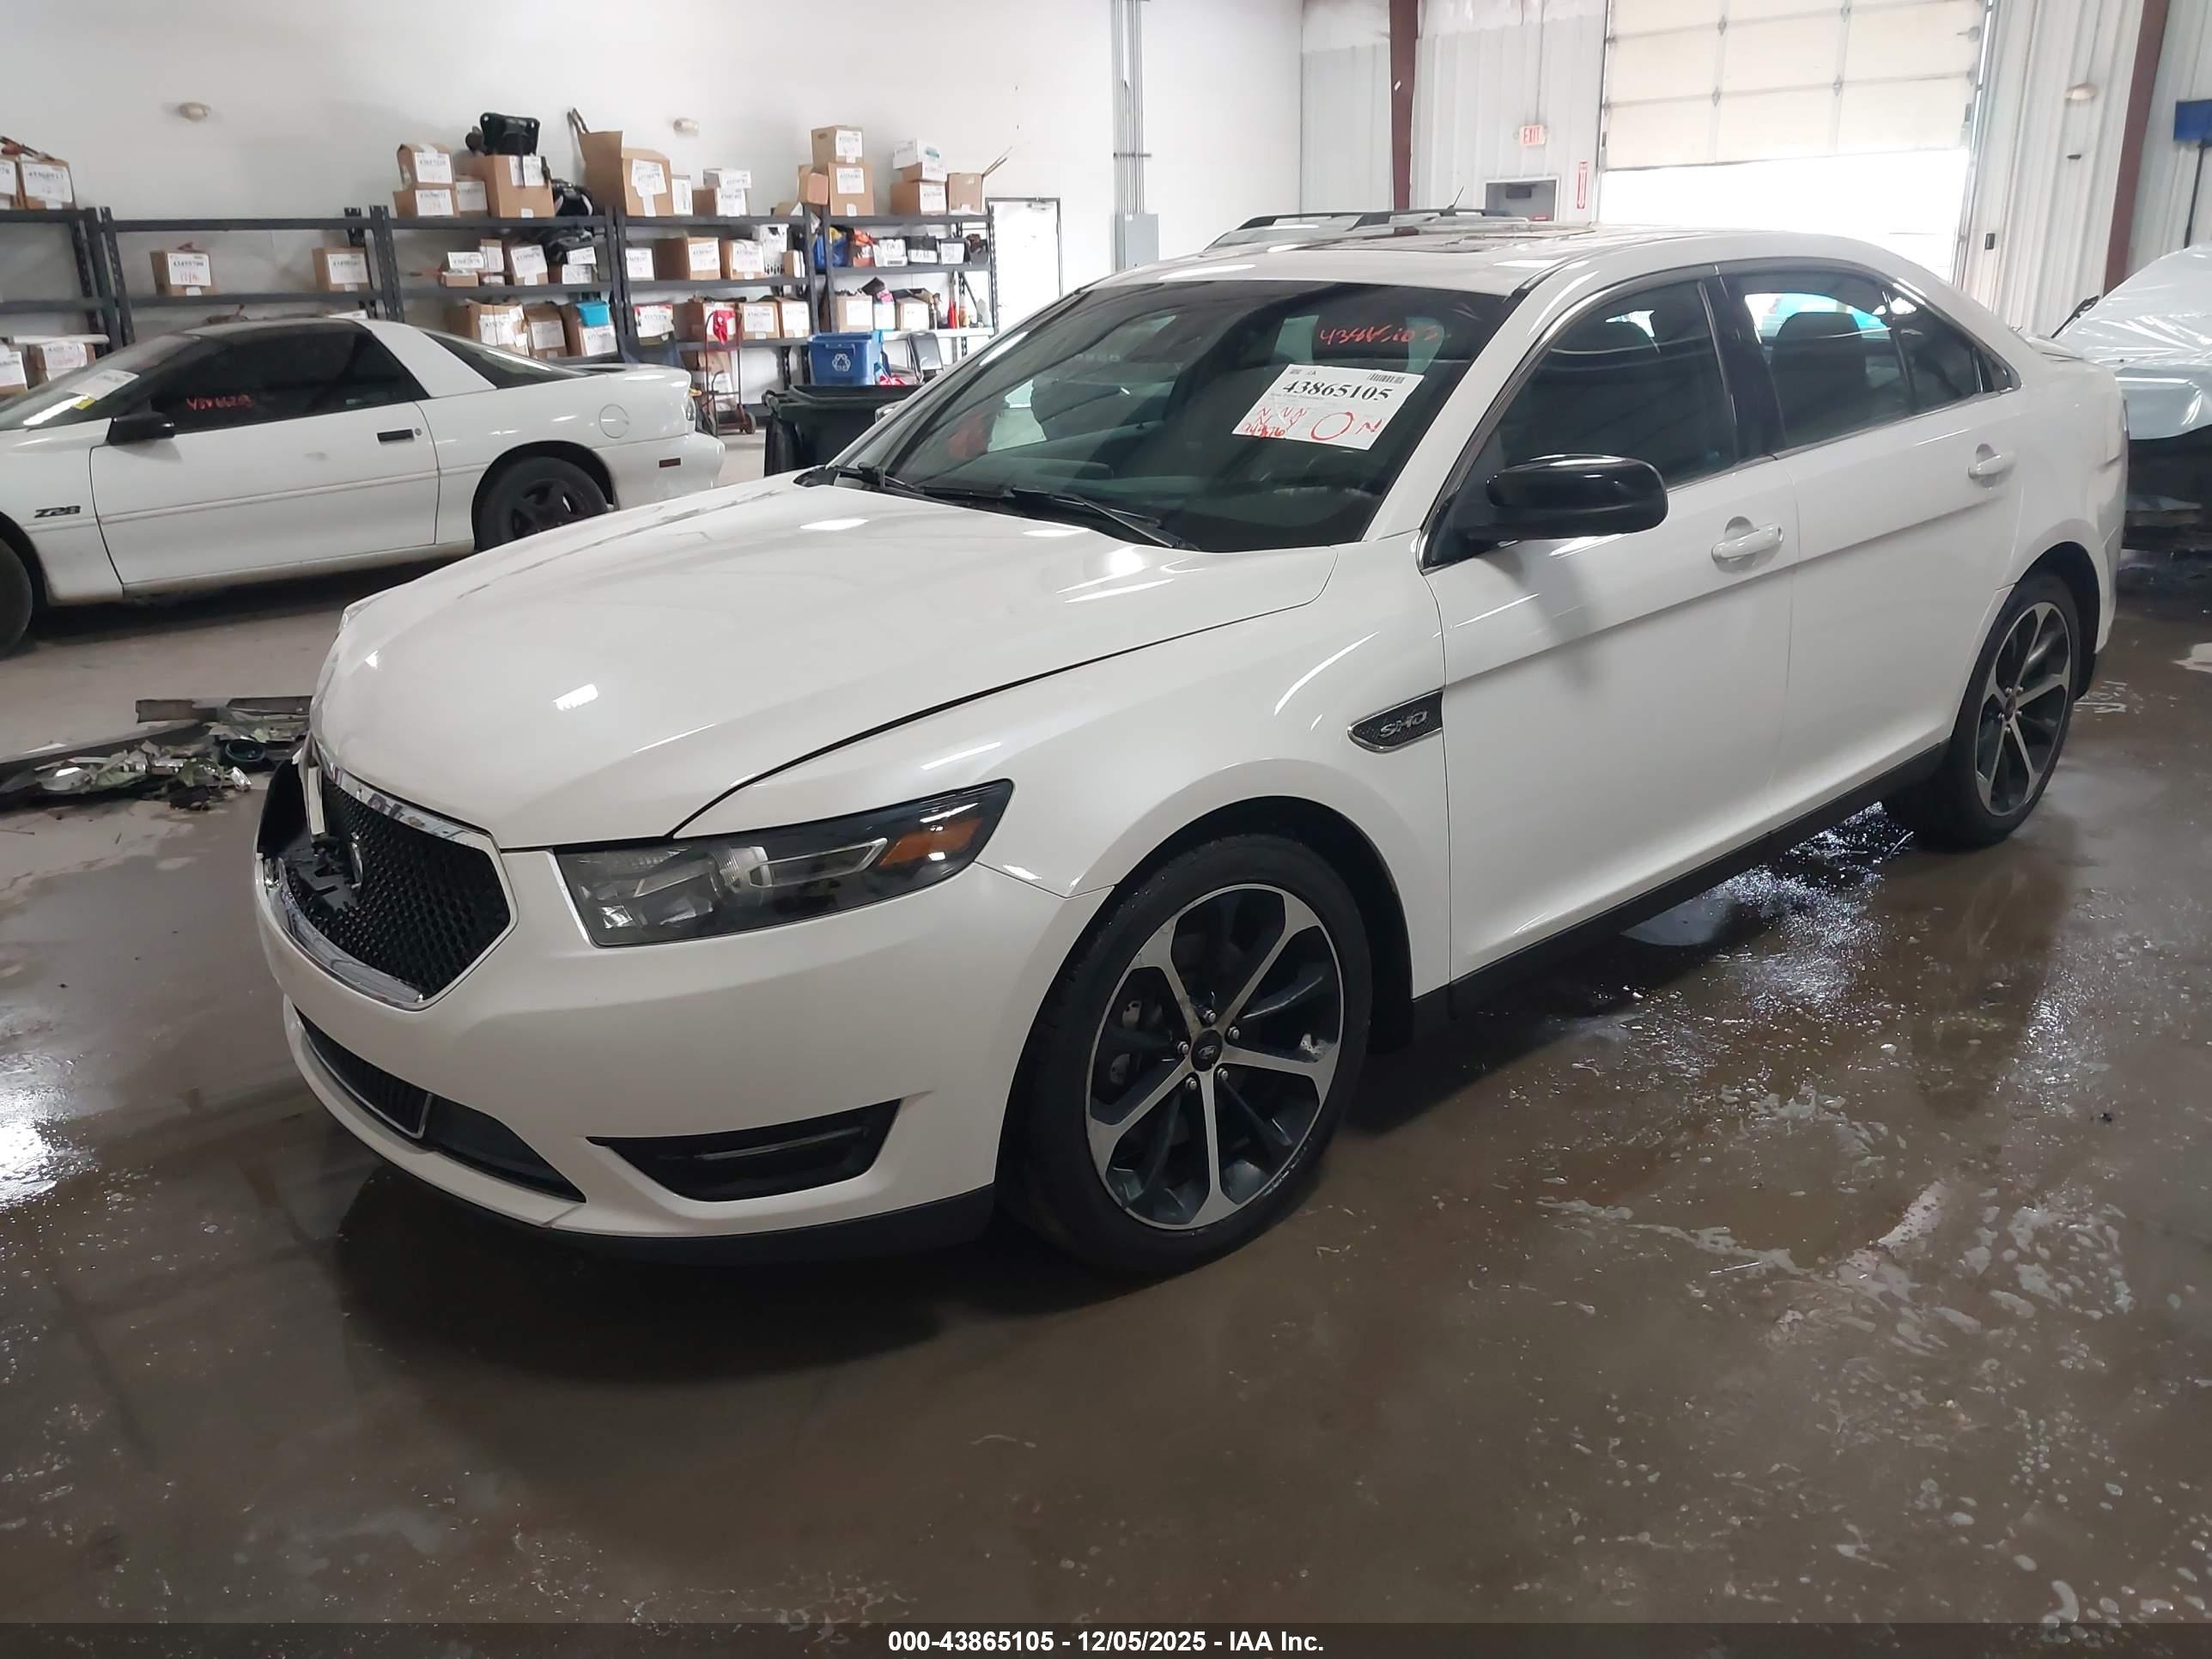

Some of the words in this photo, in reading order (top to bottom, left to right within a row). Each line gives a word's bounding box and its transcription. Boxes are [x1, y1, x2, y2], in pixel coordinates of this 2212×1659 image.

[1523, 127, 1540, 143] EXIT
[1282, 380, 1394, 402] 43865105
[1380, 710, 1428, 738] SHO
